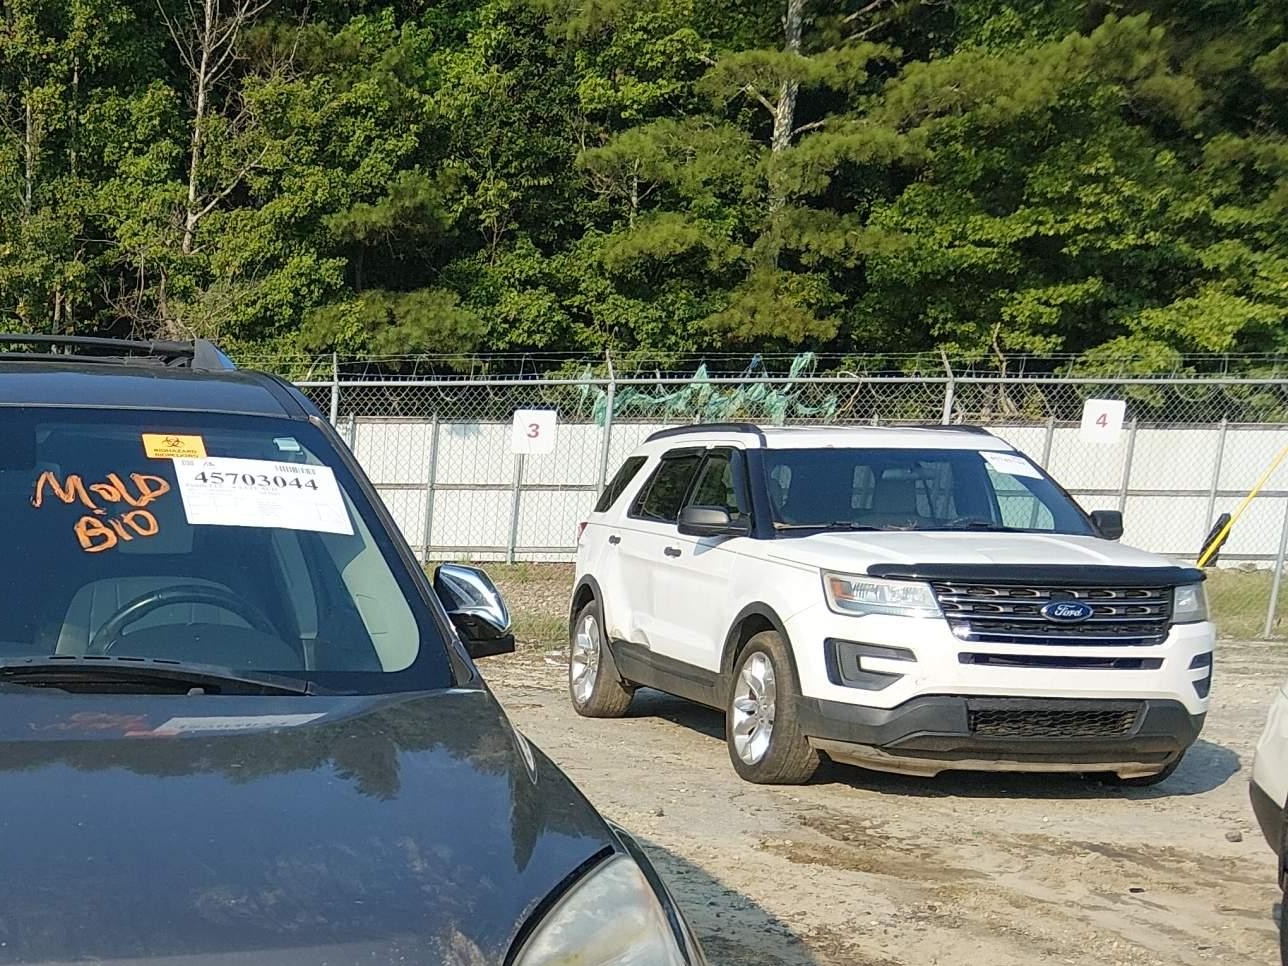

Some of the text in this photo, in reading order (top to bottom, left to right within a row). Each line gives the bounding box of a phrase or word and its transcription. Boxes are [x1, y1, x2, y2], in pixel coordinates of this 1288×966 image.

[1095, 413, 1109, 428] 4
[527, 423, 540, 438] 3
[194, 471, 319, 491] 45703044
[1054, 604, 1083, 617] Ford
